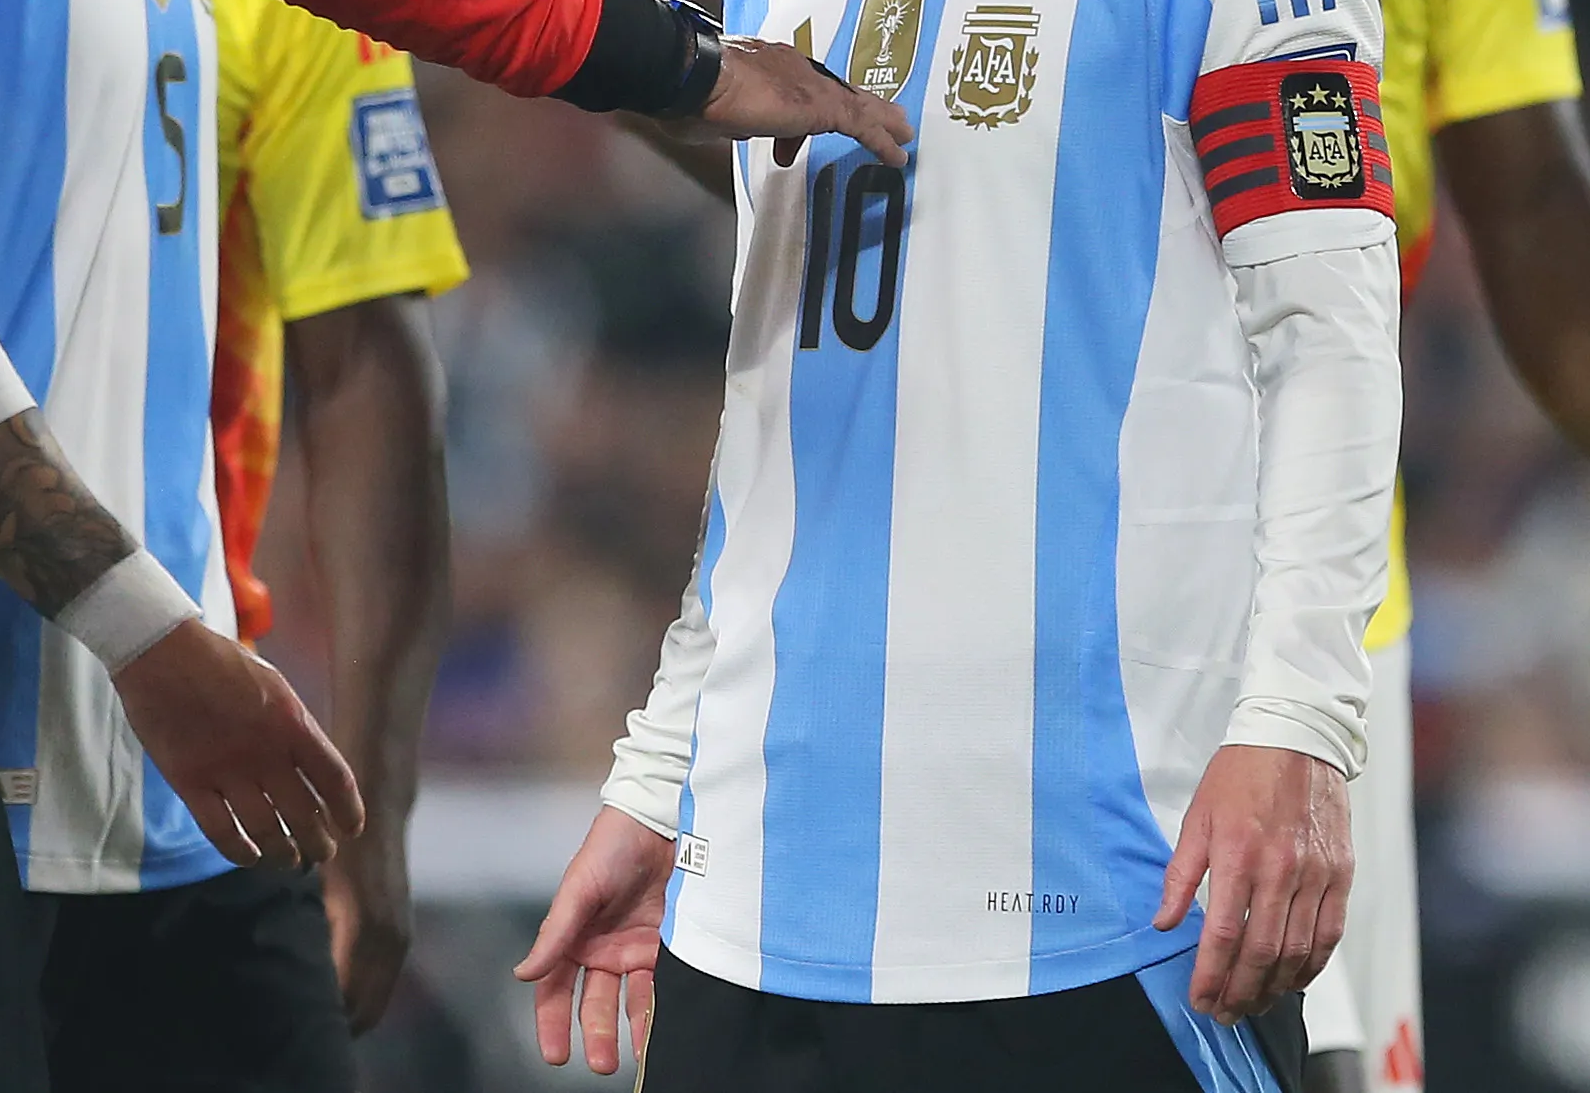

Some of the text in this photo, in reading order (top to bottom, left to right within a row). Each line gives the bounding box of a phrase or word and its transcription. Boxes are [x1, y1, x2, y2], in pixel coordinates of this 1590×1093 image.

[864, 67, 894, 84] FIFA
[963, 35, 1016, 94] AFA
[155, 52, 186, 235] 5
[1309, 132, 1345, 166] AFA
[800, 162, 906, 353] 10
[986, 891, 1079, 914] HEAT.RDY
